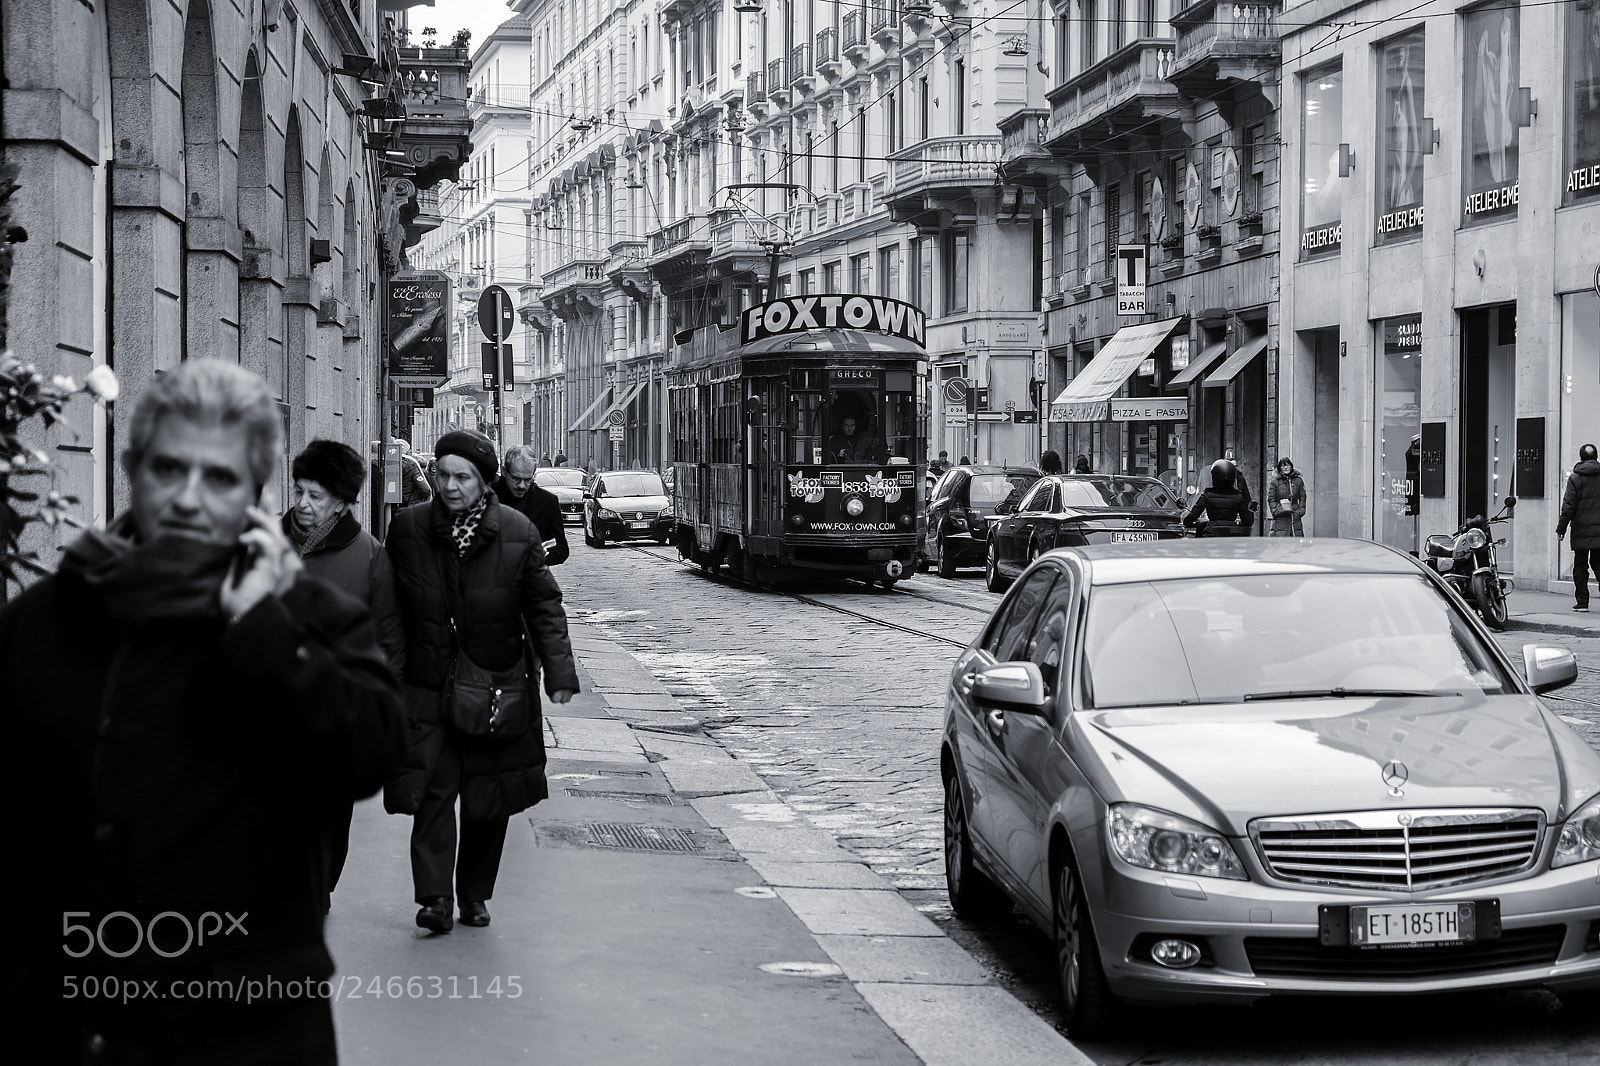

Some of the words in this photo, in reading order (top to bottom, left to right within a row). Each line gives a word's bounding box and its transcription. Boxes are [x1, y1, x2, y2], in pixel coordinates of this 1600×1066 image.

[1464, 189, 1499, 215] ATELIER
[1377, 210, 1407, 234] ATELIER
[1301, 229, 1327, 250] ATELIER
[1119, 249, 1144, 286] T
[1119, 301, 1145, 311] BAR
[747, 296, 924, 344] FOXTOWN
[837, 370, 872, 378] GRECO
[1112, 409, 1141, 418] PIZZA
[1144, 409, 1152, 417] E
[1156, 408, 1187, 417] PASTA
[802, 478, 821, 488] FOX
[842, 481, 869, 493] 1853
[882, 478, 900, 488] FOX
[1391, 478, 1414, 496] SALDI
[790, 487, 822, 497] TOWN
[870, 487, 900, 497] TOWN
[810, 522, 896, 531] WWW.FOXTOWN.COM
[1369, 914, 1392, 936] ET
[1401, 911, 1457, 935] 185TH
